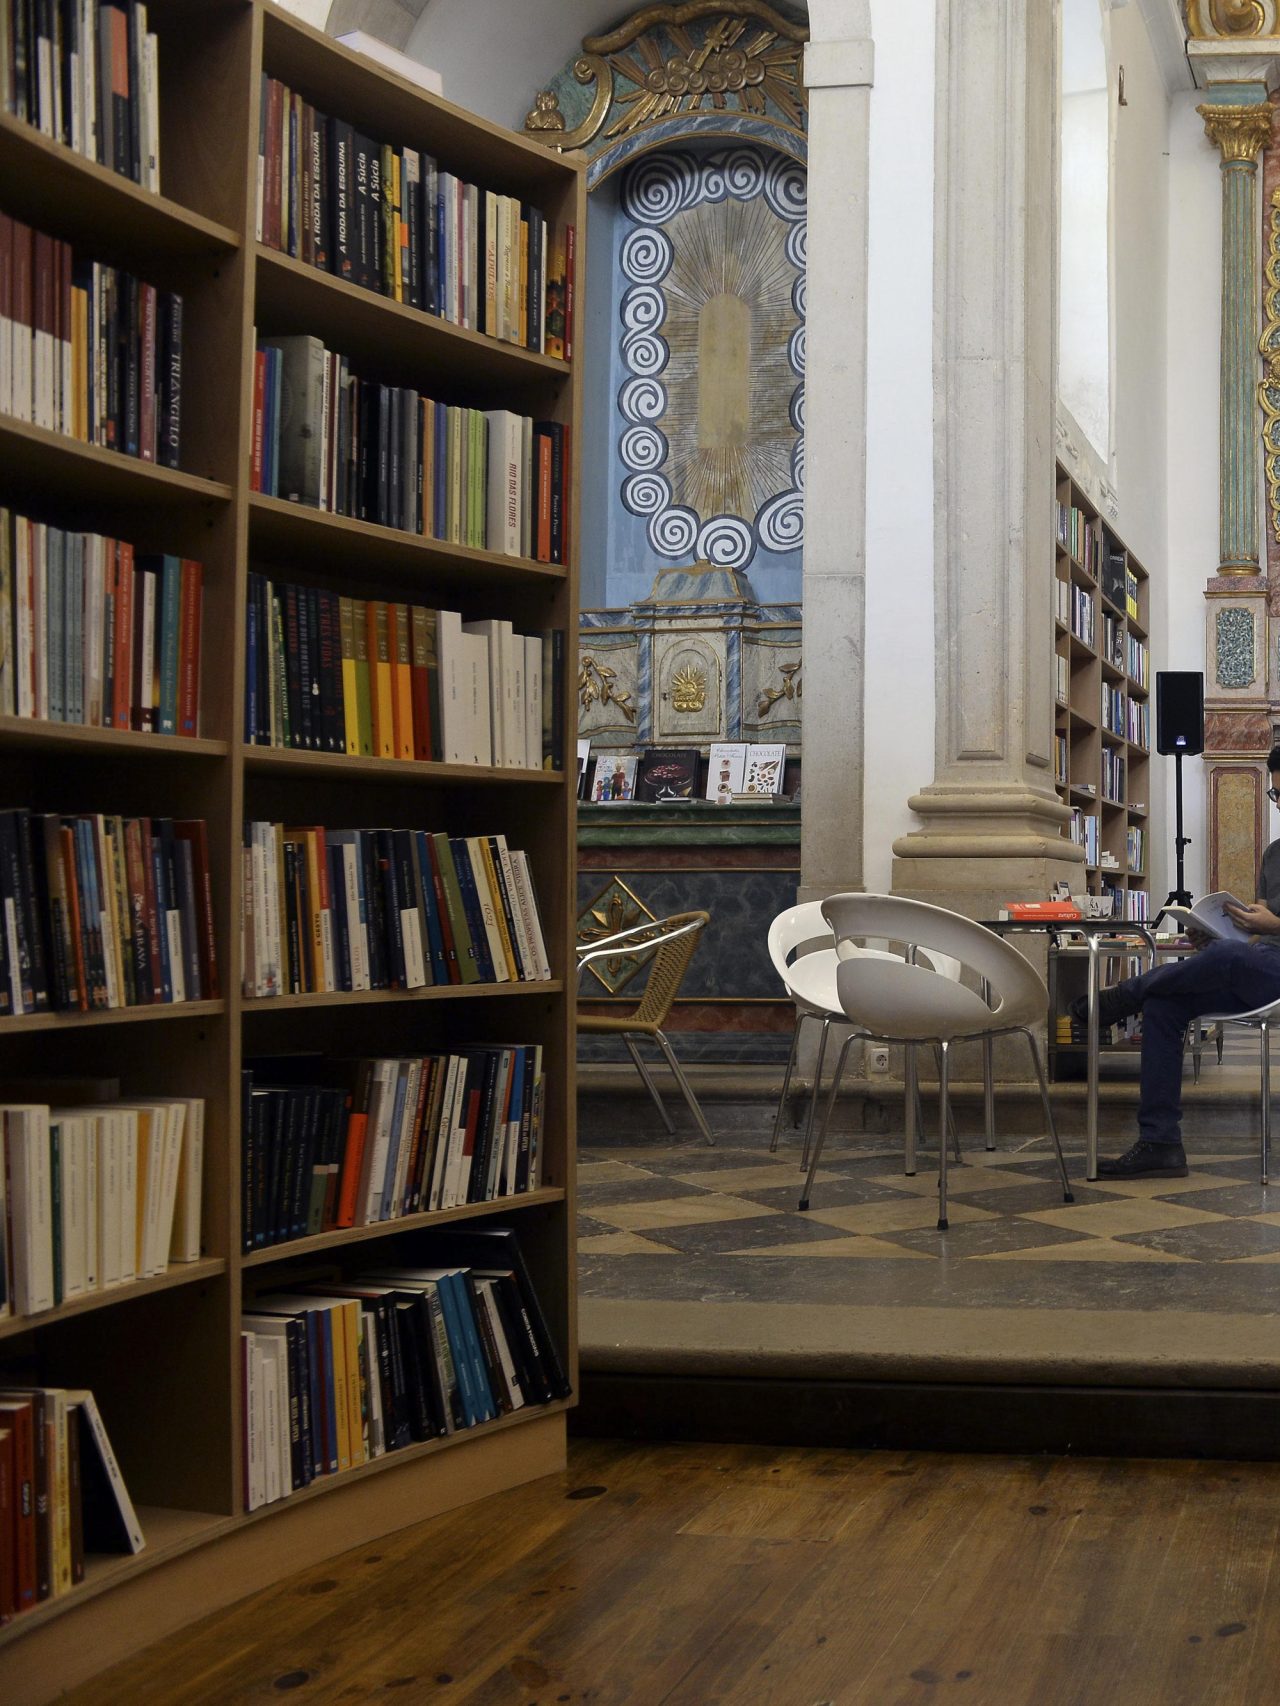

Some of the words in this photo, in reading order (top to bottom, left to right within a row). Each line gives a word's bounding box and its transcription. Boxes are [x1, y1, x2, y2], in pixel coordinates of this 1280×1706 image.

[313, 131, 321, 178] ESQUINA
[338, 141, 346, 187] ESQUINA
[357, 152, 366, 184] Súcia
[370, 159, 380, 190] Súcia
[314, 181, 321, 198] DA
[338, 190, 346, 206] DA
[360, 186, 367, 195] A
[371, 192, 380, 202] A
[313, 199, 321, 234] RODA
[338, 208, 346, 241] RODA
[314, 236, 321, 245] A
[339, 244, 346, 254] A
[508, 462, 517, 478] RIO
[507, 478, 517, 495] DAS
[507, 496, 516, 527] FLORES
[498, 846, 509, 867] ALICE
[503, 868, 515, 892] VIEIRA
[511, 857, 522, 884] VIEIRA
[517, 884, 527, 906] ALICE
[313, 912, 321, 938] GESTO
[482, 901, 494, 928] 1621
[134, 929, 146, 969] BRAVA
[352, 945, 361, 974] MUROS
[529, 944, 537, 956] OS
